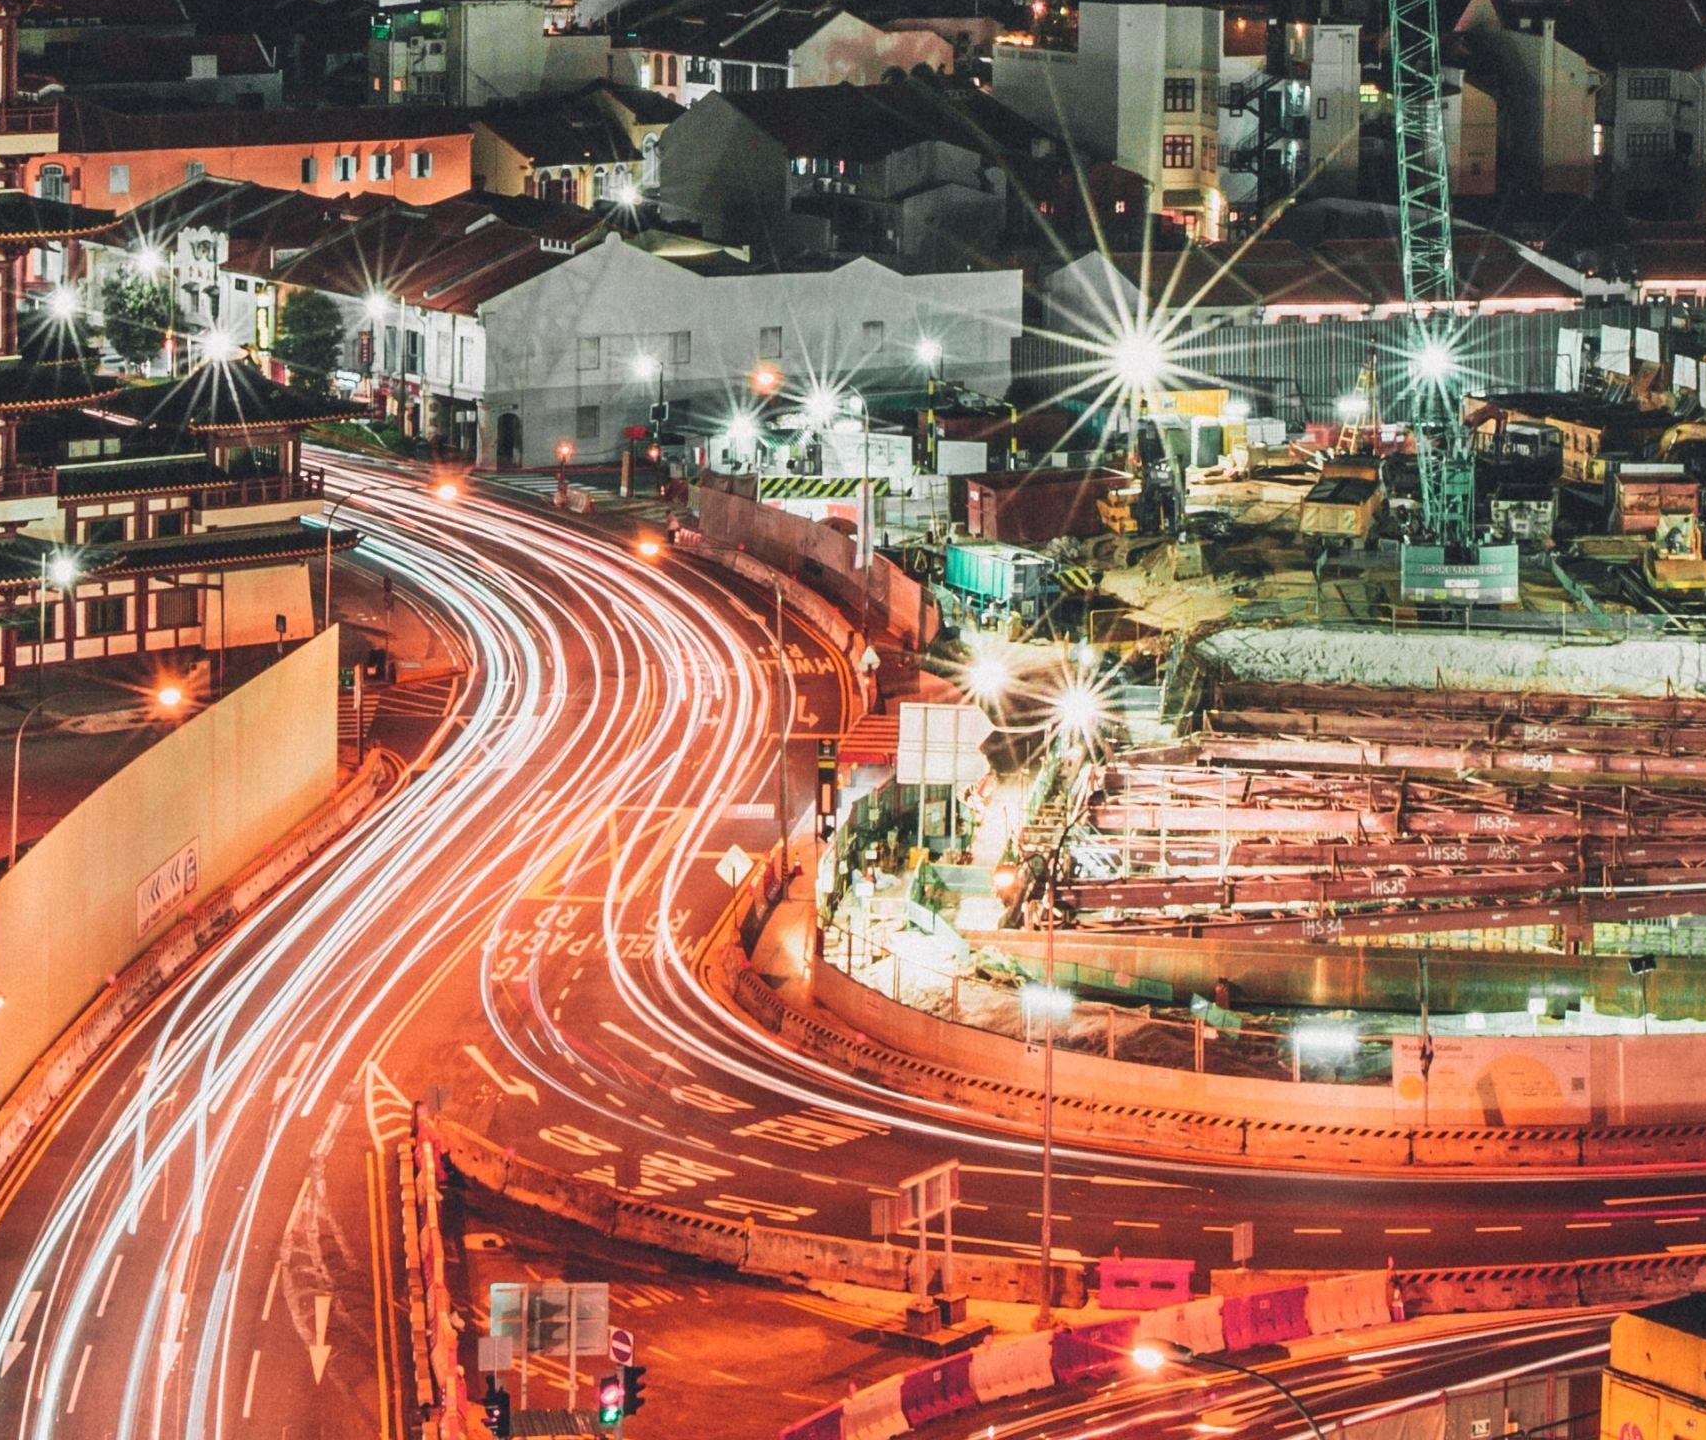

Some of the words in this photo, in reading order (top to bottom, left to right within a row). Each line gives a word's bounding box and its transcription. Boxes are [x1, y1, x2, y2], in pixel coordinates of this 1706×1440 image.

[534, 904, 583, 929] RD
[644, 908, 693, 934] RD
[490, 956, 539, 983] TG
